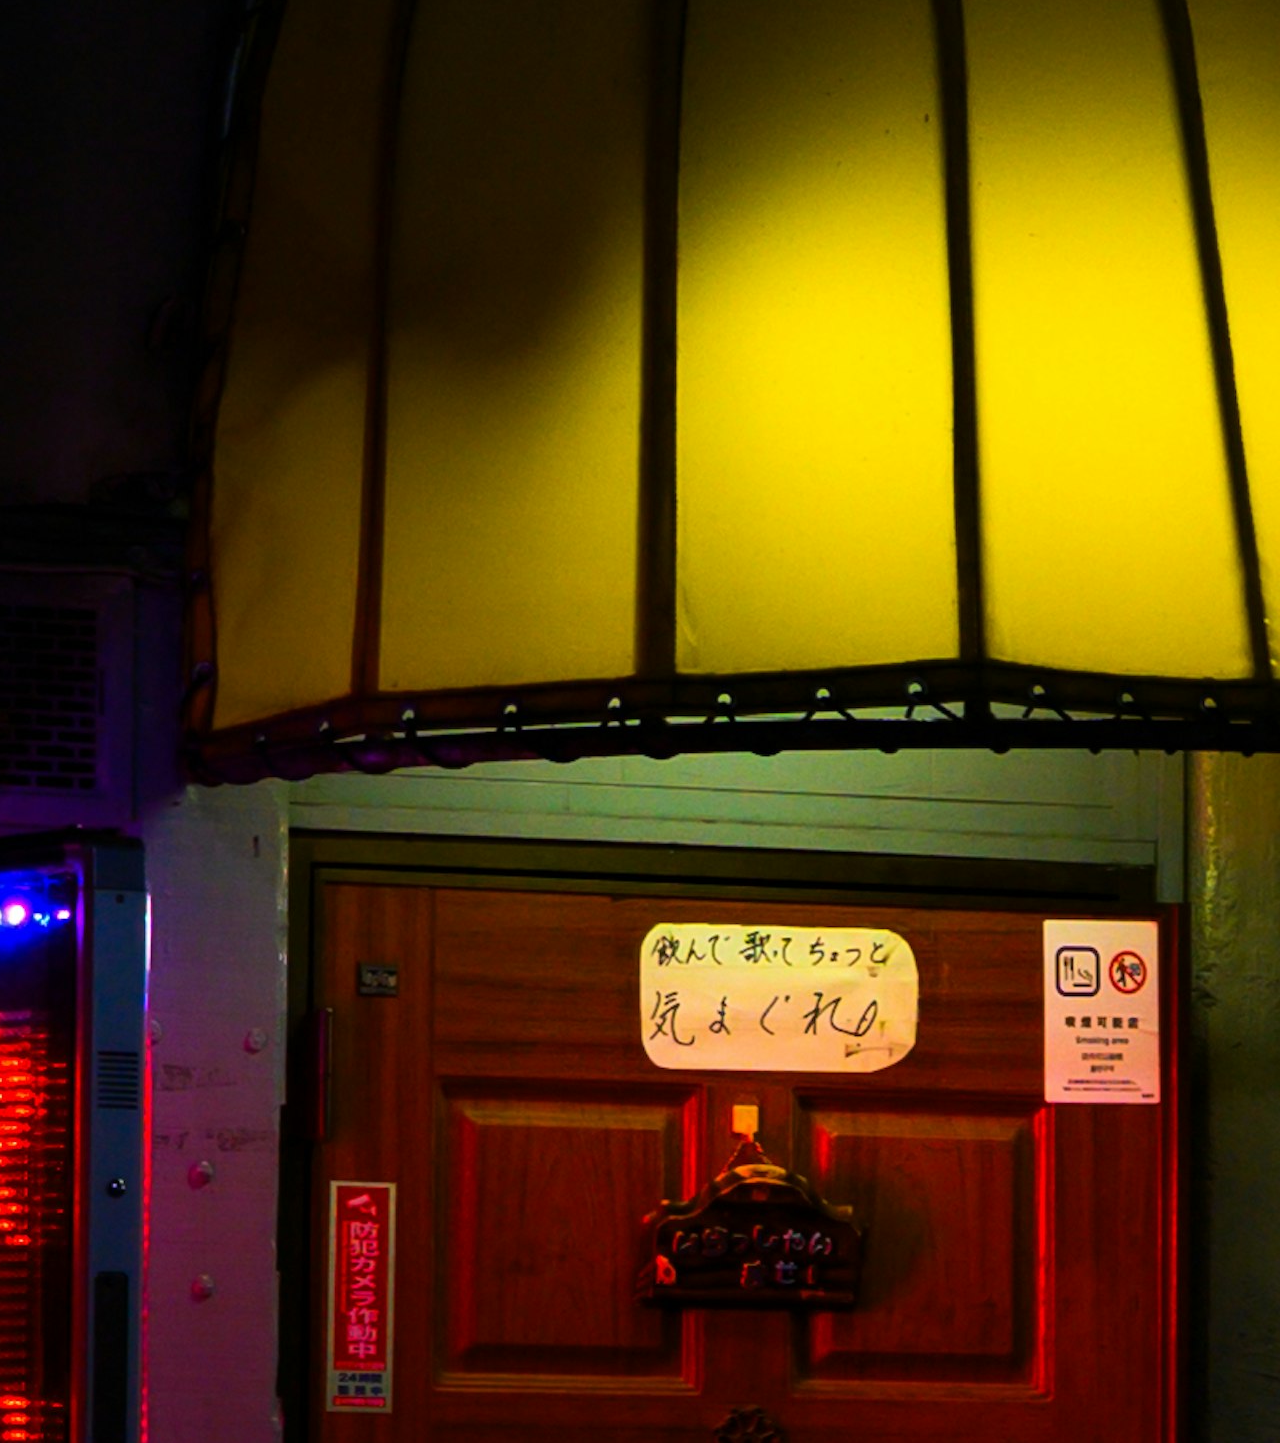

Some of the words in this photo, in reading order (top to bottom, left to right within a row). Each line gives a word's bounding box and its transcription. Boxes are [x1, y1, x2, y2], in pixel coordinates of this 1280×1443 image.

[346, 1221, 380, 1360] 防犯カメラ作動中
